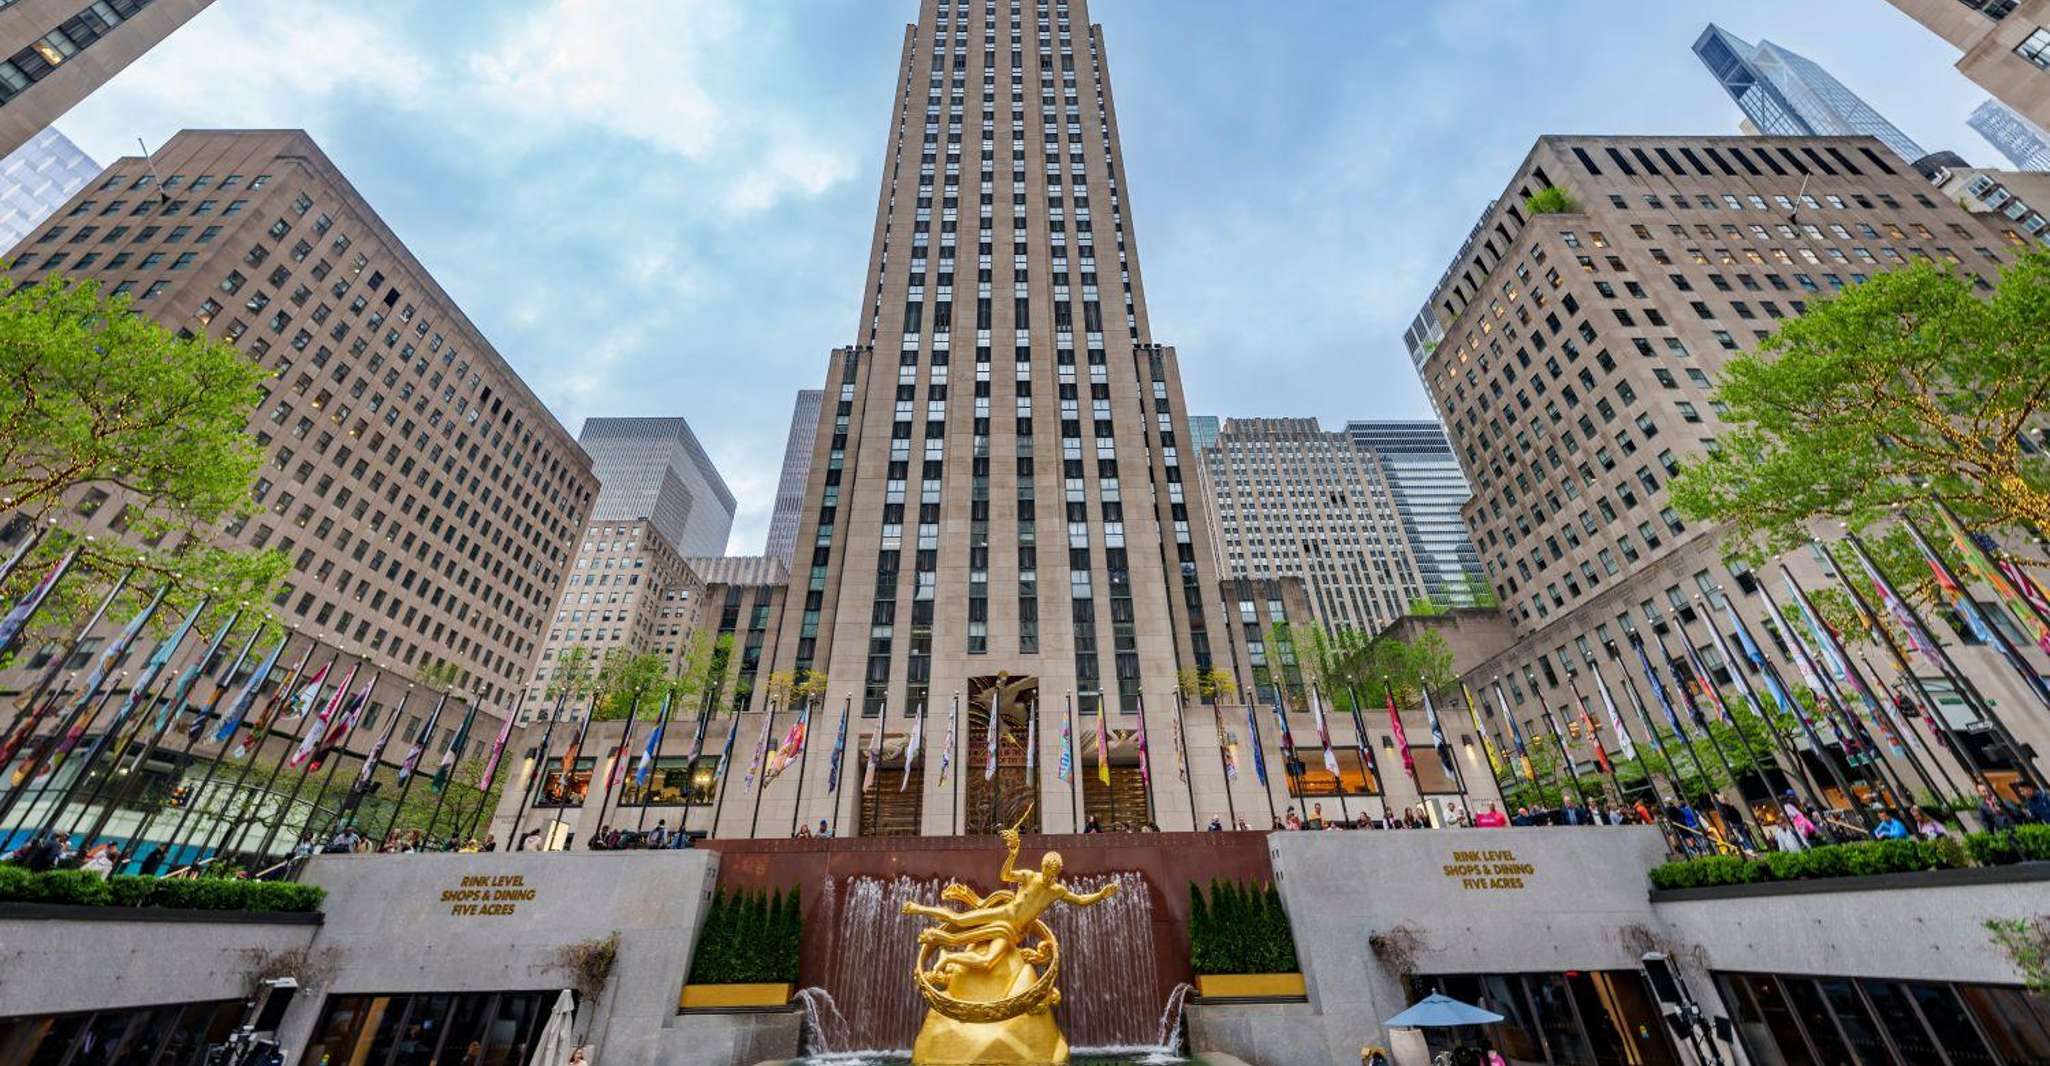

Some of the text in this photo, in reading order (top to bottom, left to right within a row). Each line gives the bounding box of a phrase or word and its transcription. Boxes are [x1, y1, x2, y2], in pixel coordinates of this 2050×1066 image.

[1453, 850, 1516, 862] RINK LEVEL
[1443, 863, 1535, 876] SHOPS & DINING
[461, 875, 525, 887] RINK LEVEL
[1462, 877, 1524, 890] FIVE ACRES
[441, 889, 536, 902] SHOPS & DINING
[451, 903, 515, 916] FIVE ACRES
